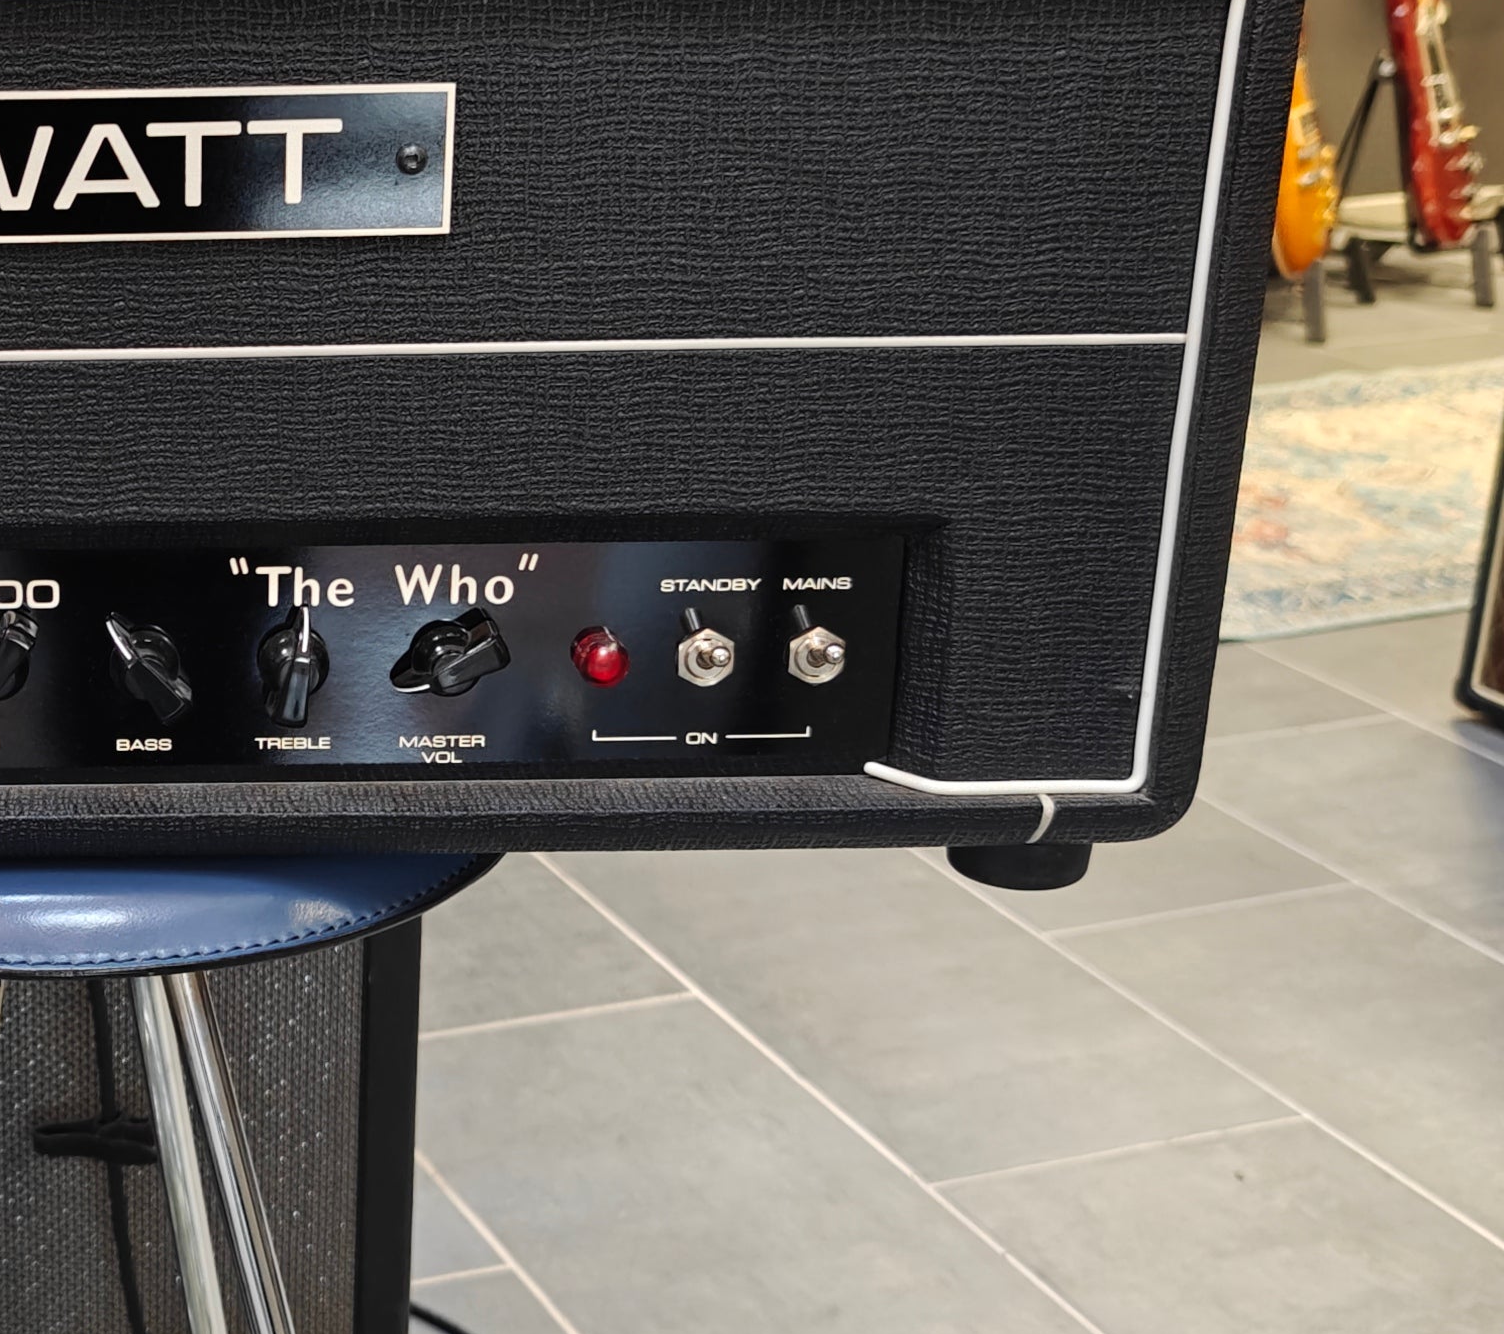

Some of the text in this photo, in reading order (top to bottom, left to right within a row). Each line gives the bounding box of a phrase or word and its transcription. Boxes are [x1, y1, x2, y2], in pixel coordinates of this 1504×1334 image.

[659, 577, 762, 593] STANDBY
[782, 576, 852, 591] MAINS
[115, 738, 173, 752] BASS
[253, 736, 332, 750] TREBLE
[398, 734, 486, 749] MASTER
[684, 731, 718, 746] ON
[420, 750, 464, 765] VOL
